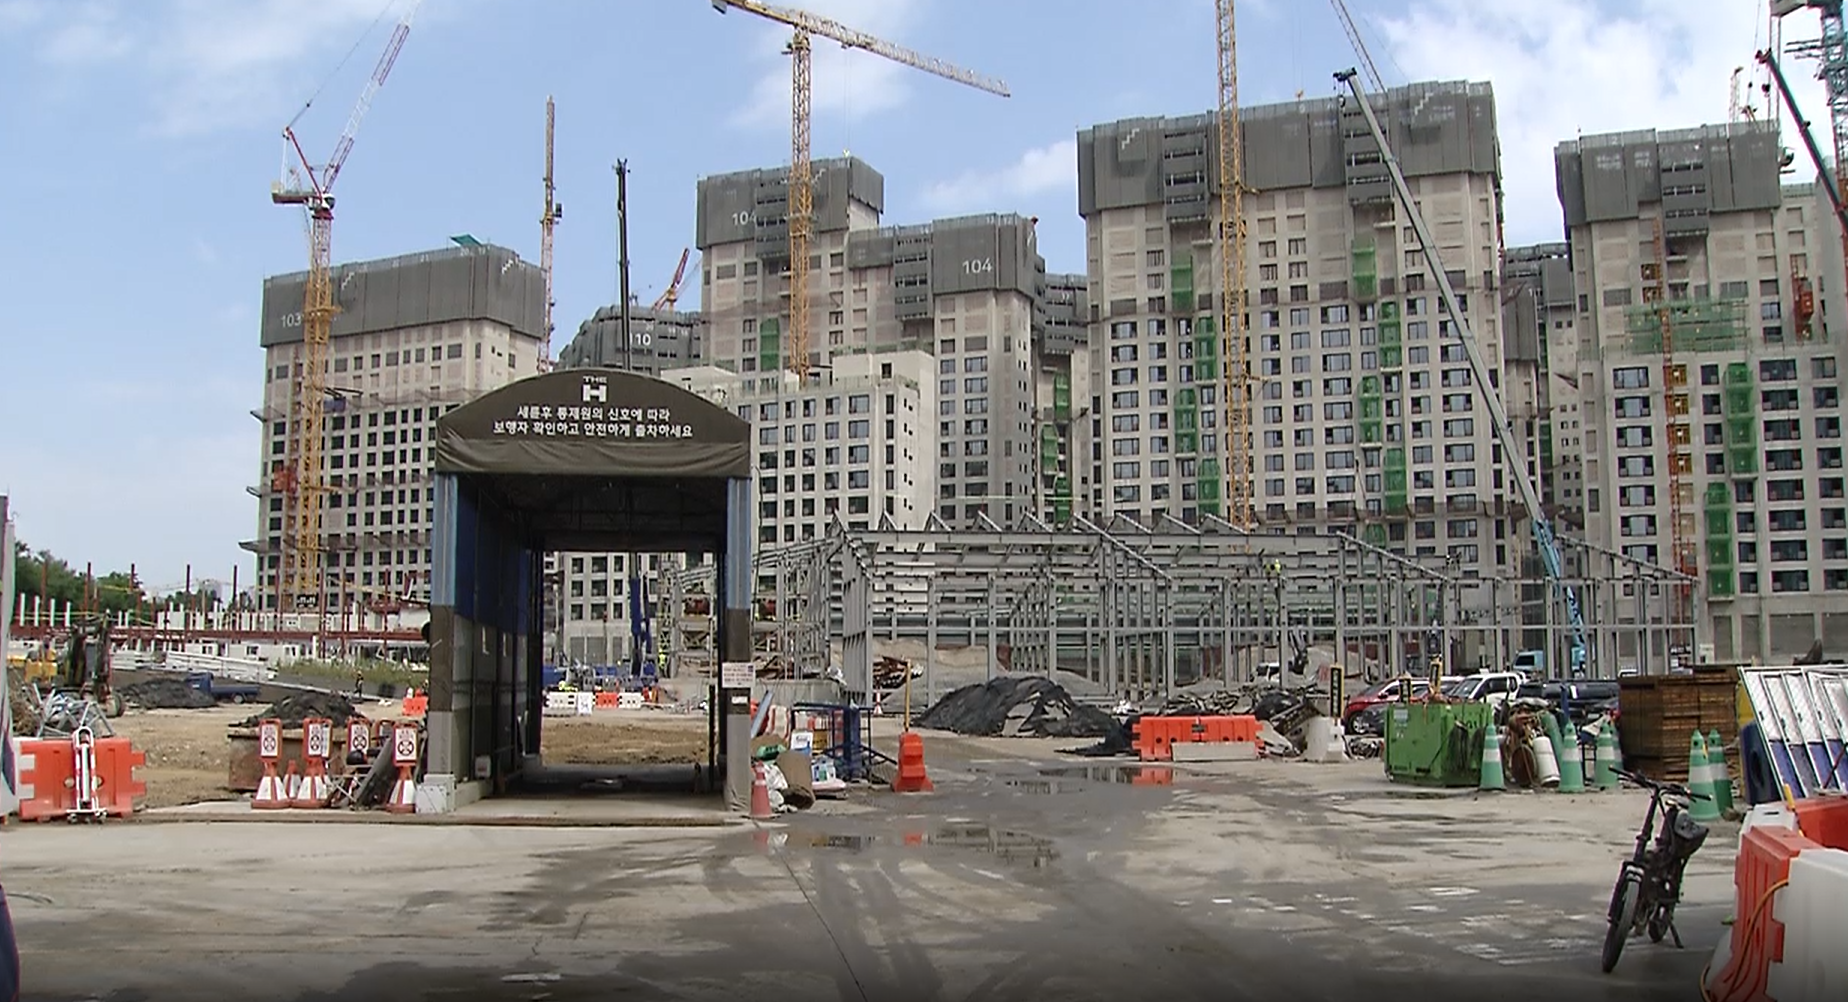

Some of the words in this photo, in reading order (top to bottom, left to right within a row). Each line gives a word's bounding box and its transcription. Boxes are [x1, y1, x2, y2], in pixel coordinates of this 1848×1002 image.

[962, 257, 993, 275] 104
[281, 312, 302, 328] 103
[582, 375, 608, 384] THE
[582, 384, 608, 402] H
[556, 406, 604, 421] 통제원의
[607, 407, 643, 422] 신호에
[646, 408, 671, 422] 따라
[492, 420, 529, 435] 보행자
[532, 421, 580, 436] 확인하고
[583, 422, 631, 438] 안전하게
[635, 423, 693, 438] 출차하세요
